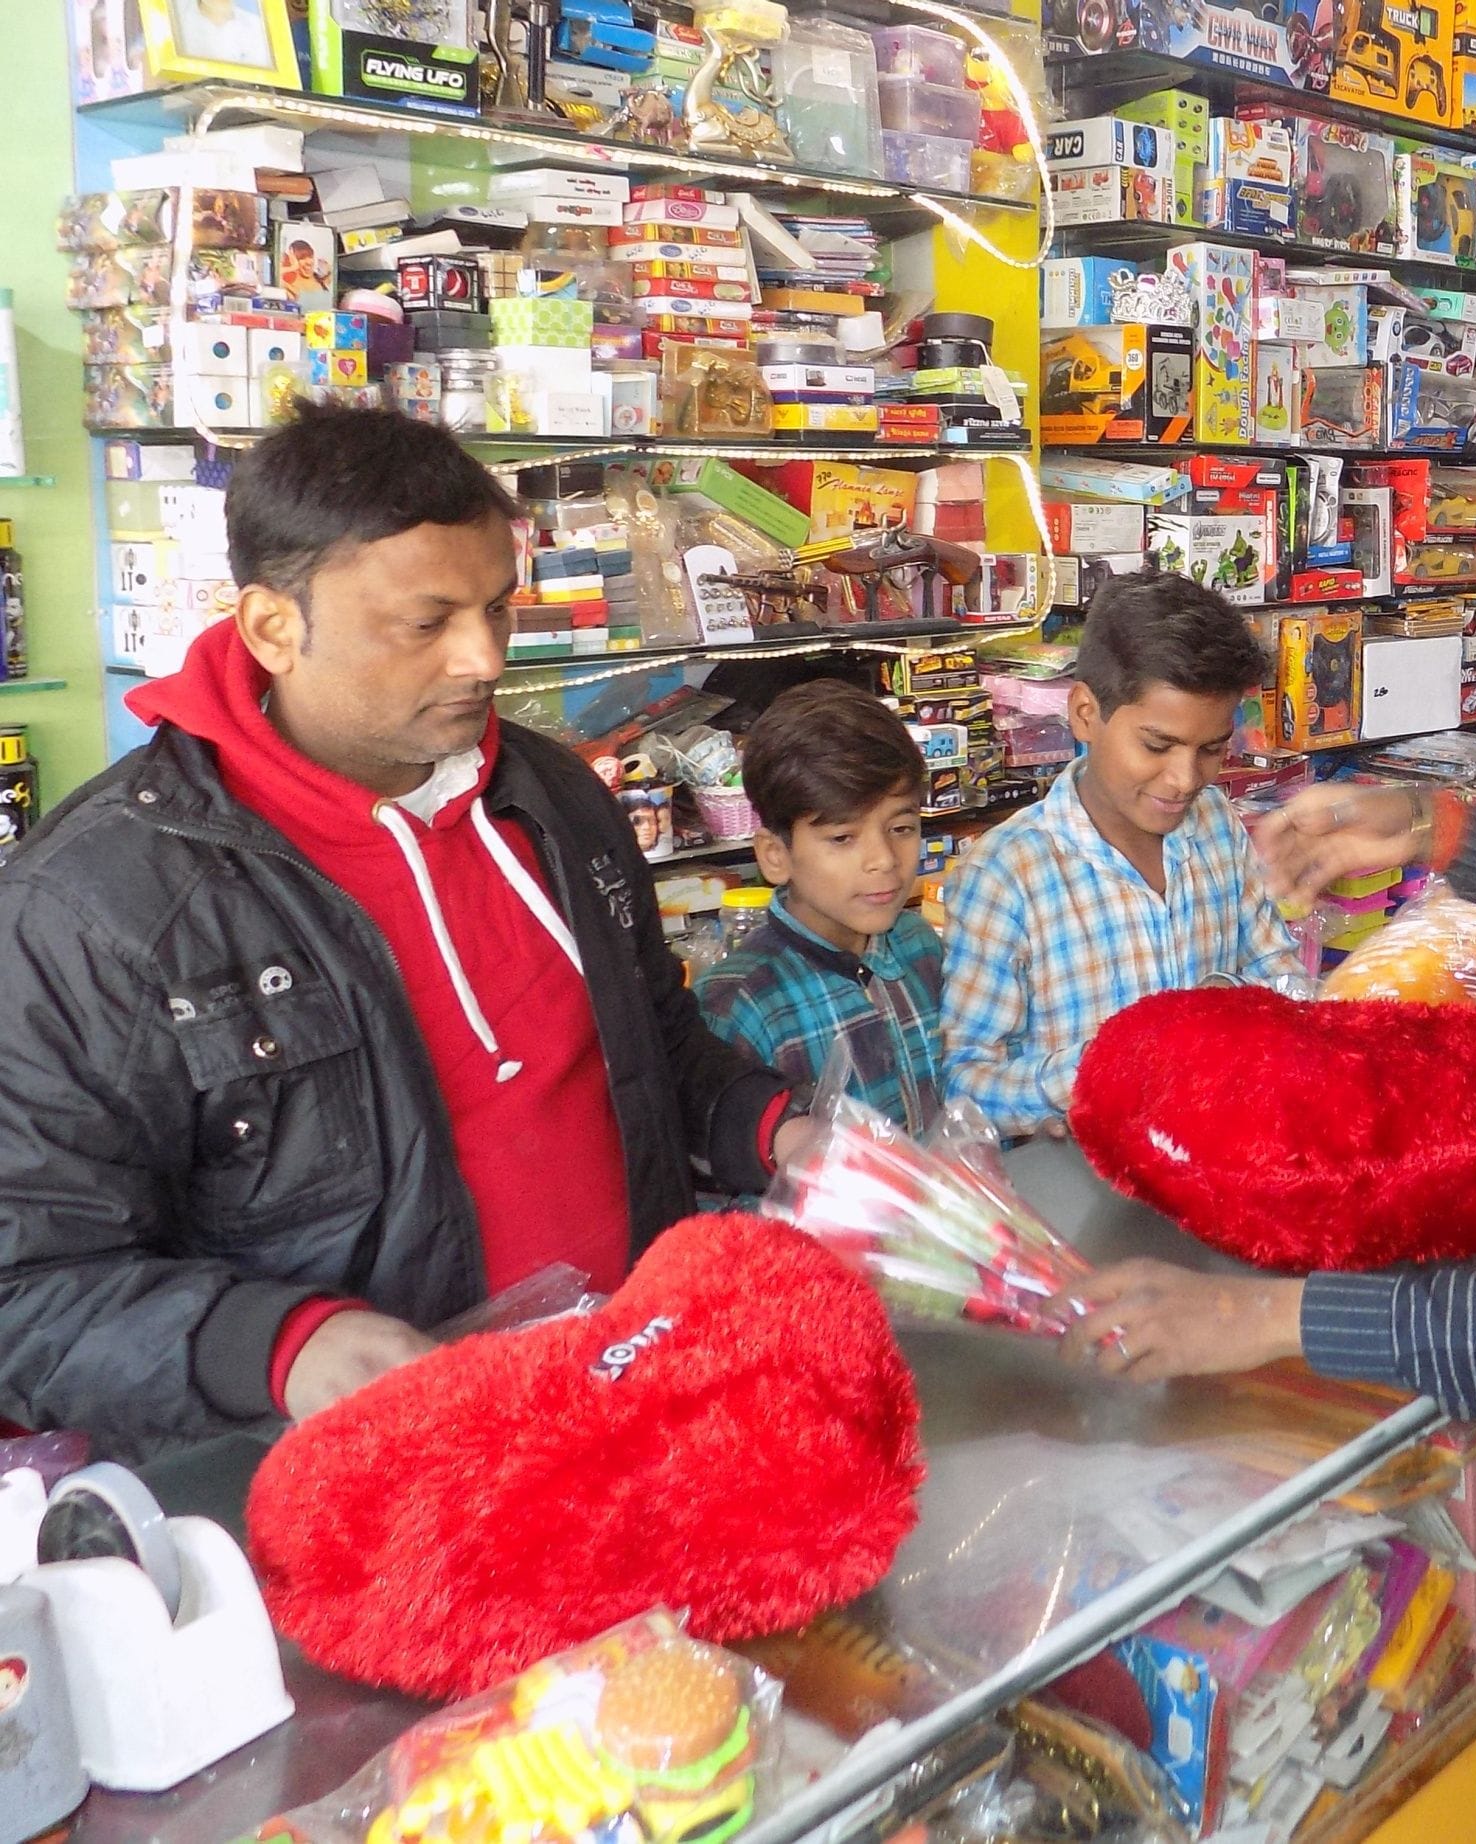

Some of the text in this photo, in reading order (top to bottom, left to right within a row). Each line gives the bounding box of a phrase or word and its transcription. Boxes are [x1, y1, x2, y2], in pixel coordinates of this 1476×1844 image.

[1387, 6, 1418, 31] TRUCK
[366, 58, 463, 88] FLYING UFO
[1054, 135, 1082, 156] CAR
[1115, 140, 1124, 161] CAR
[1239, 325, 1250, 440] Dough Factory
